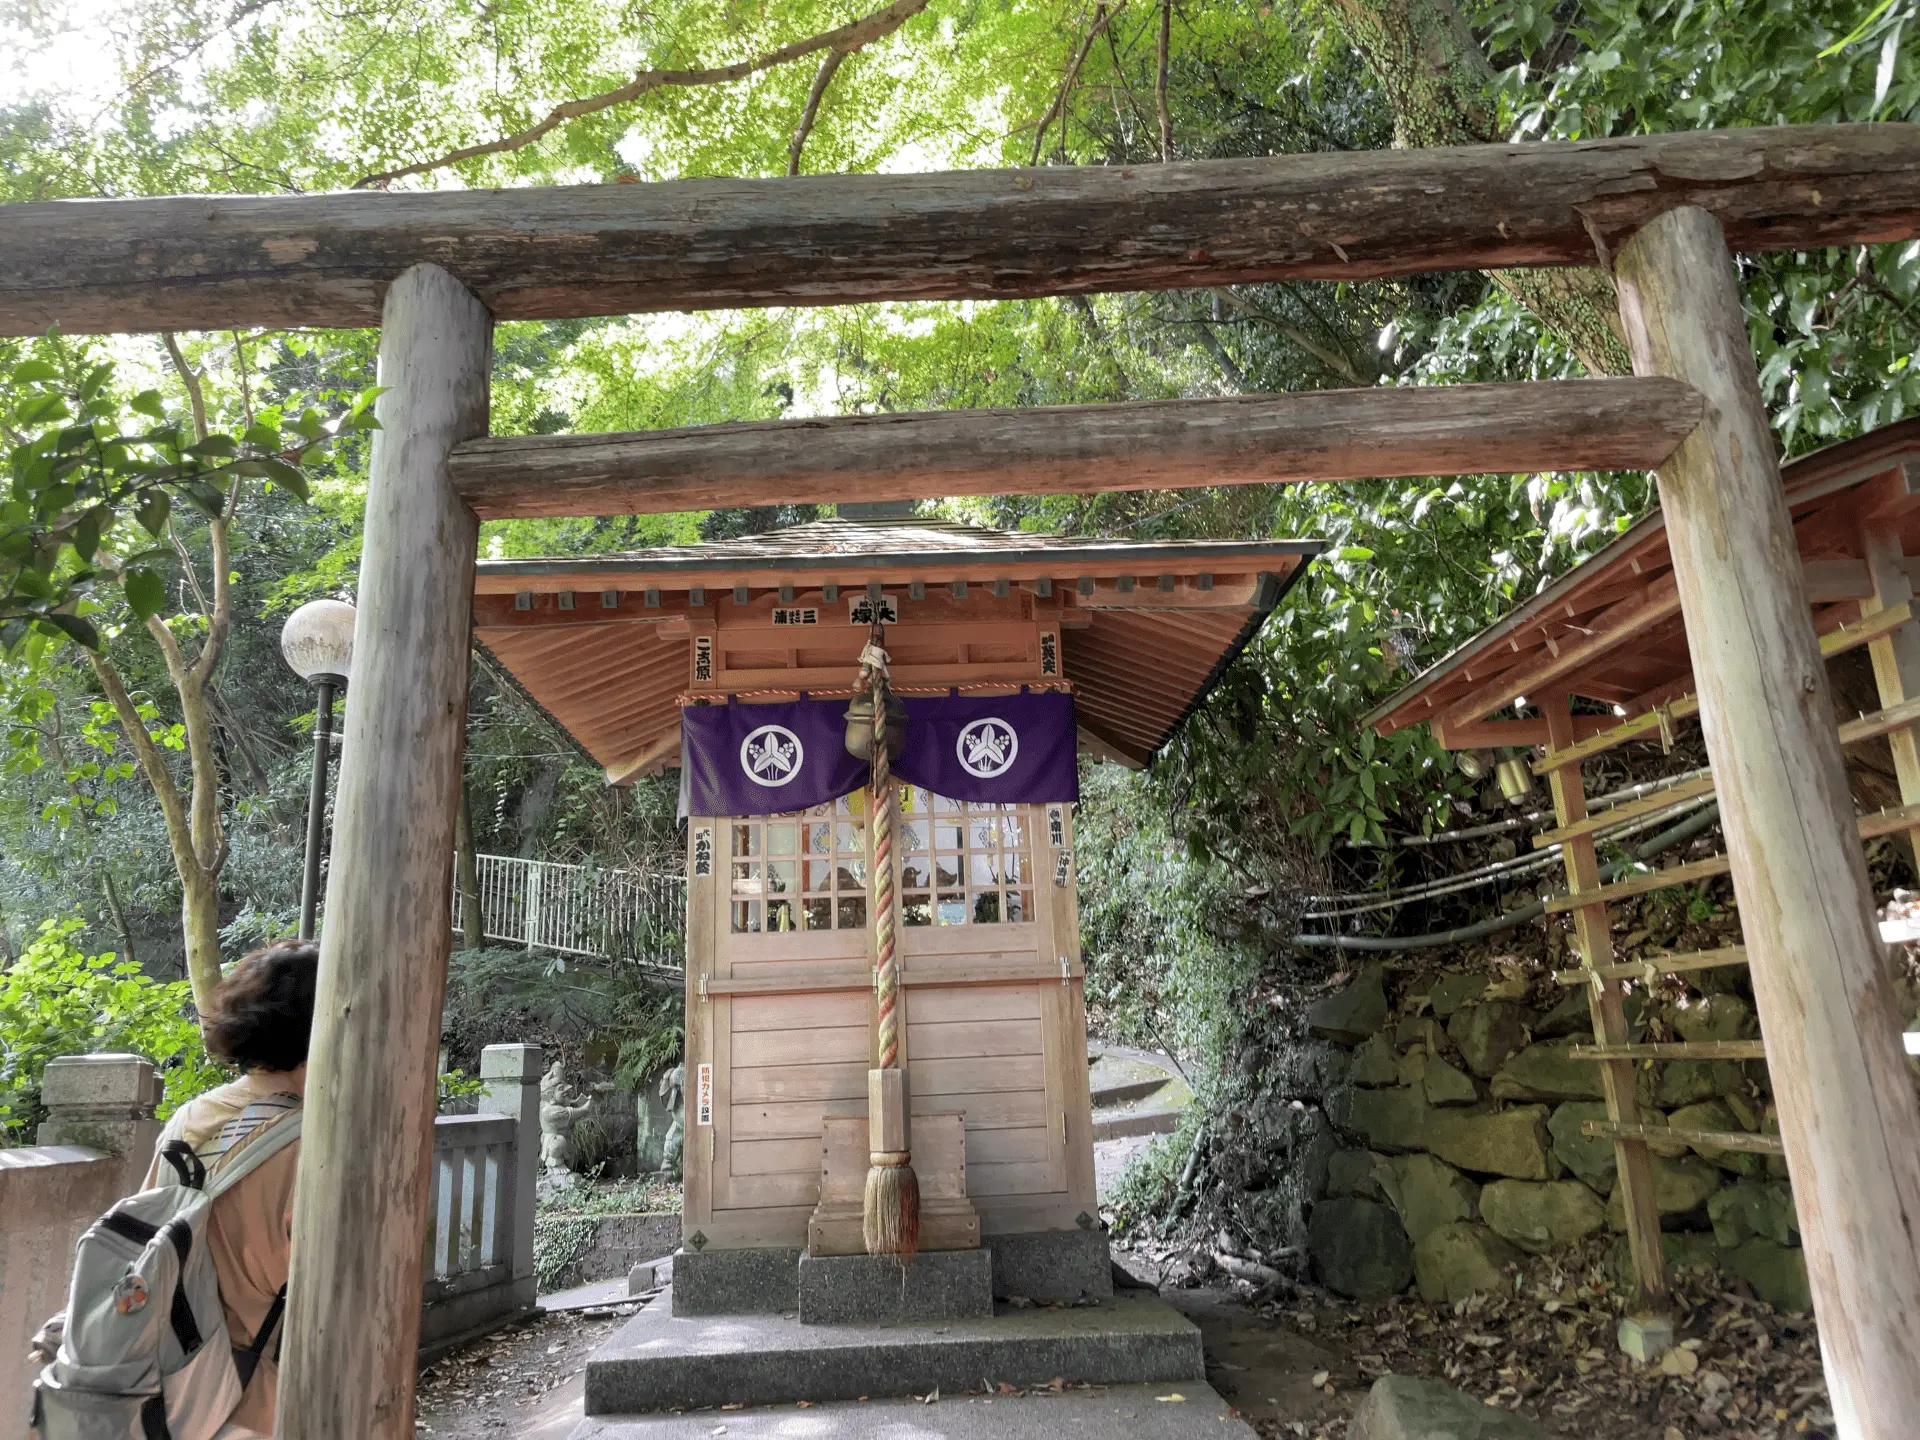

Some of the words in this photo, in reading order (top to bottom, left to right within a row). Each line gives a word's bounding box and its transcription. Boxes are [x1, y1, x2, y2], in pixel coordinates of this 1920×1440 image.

[701, 1066, 710, 1122] 防犯カメラ設置
